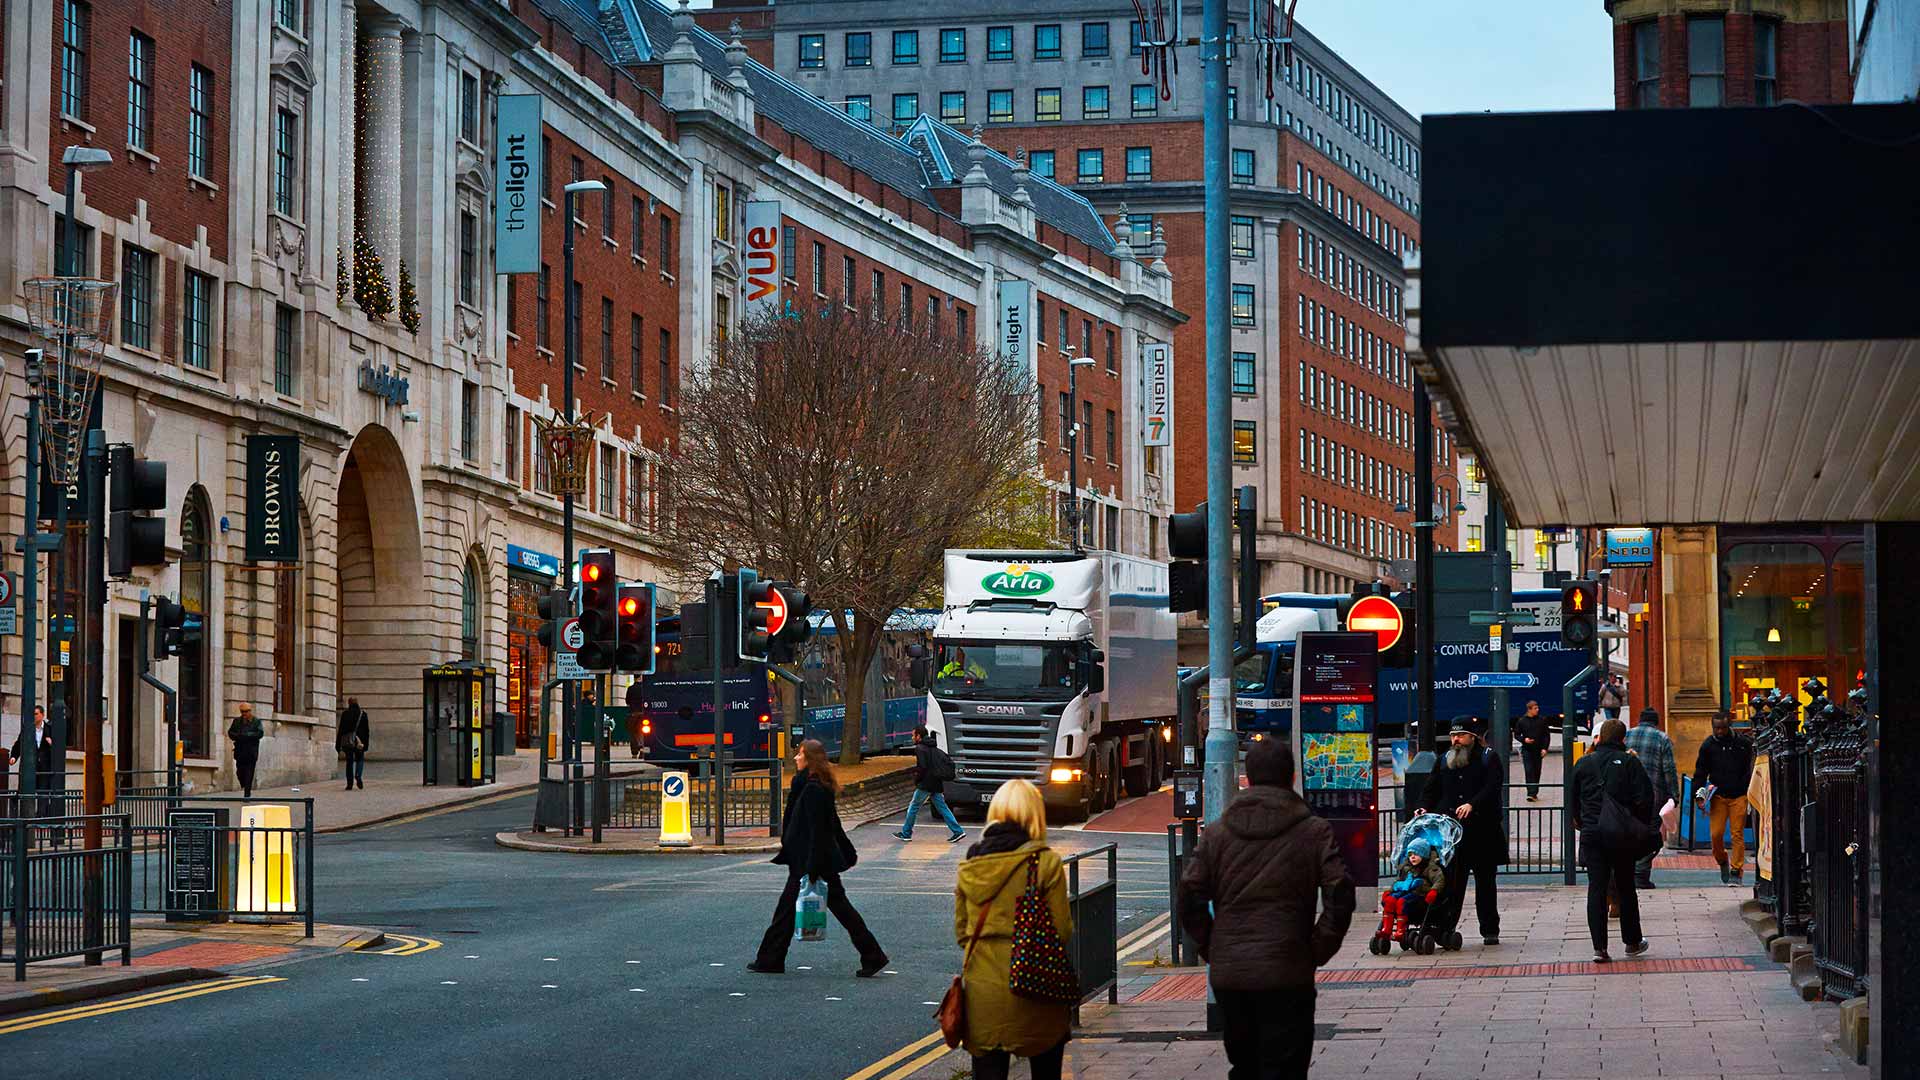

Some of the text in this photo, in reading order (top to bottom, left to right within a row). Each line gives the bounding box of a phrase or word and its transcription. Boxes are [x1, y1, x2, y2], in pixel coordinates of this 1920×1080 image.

[505, 134, 529, 233] thelight
[747, 226, 778, 301] vue
[1154, 348, 1165, 415] ORIGIN
[265, 450, 280, 545] BROWNS
[1610, 546, 1651, 556] NERO
[992, 574, 1042, 590] Arla
[1440, 643, 1489, 656] CONTRAC
[1524, 641, 1584, 653] SPECIAL
[701, 700, 750, 712] Hyerlink
[977, 705, 1026, 715] SCANIA
